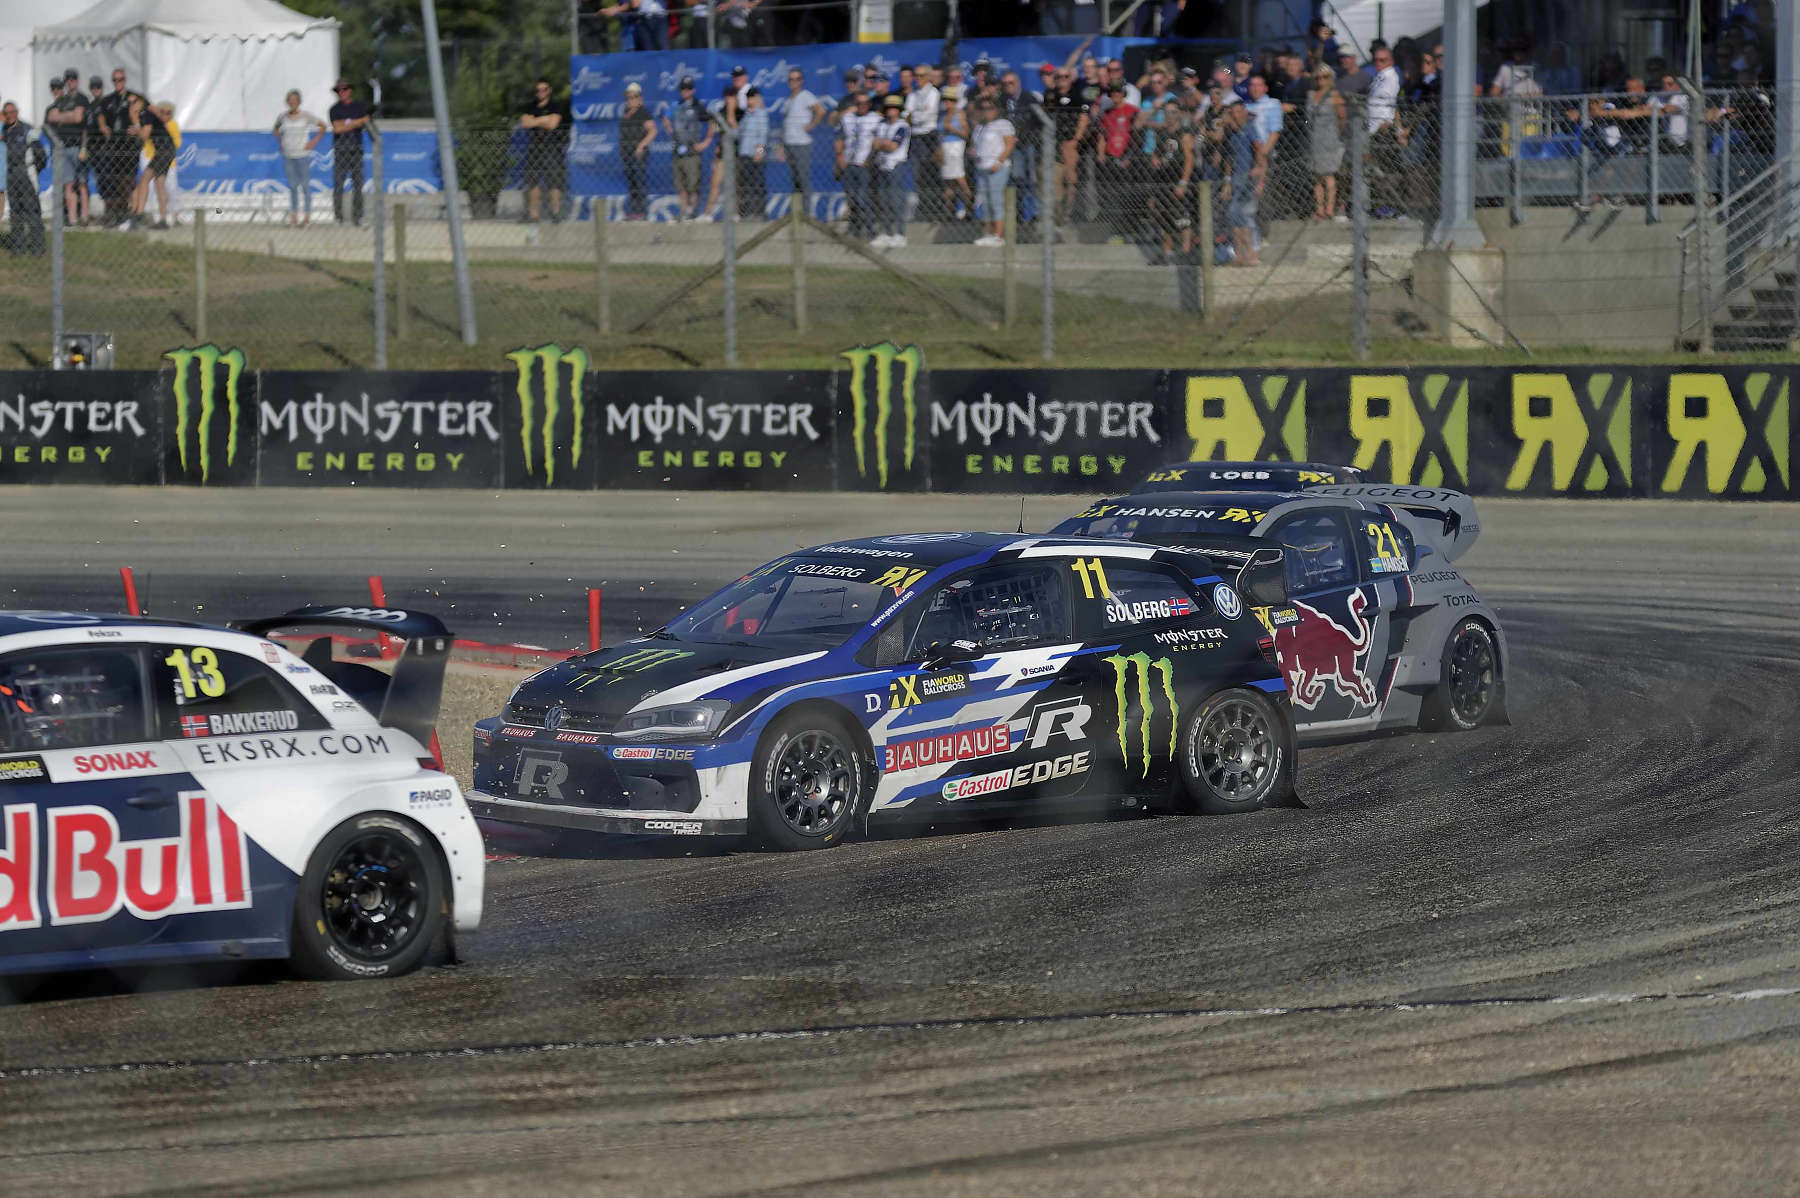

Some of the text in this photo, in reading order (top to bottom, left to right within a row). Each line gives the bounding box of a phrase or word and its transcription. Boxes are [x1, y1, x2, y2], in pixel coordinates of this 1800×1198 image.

[0, 446, 112, 463] ERGY
[297, 452, 464, 471] ENERGY
[638, 450, 787, 468] ENERGY
[966, 455, 1126, 474] ENERGY
[1210, 471, 1269, 480] LOEB
[1114, 507, 1215, 519] HANSEN
[1368, 522, 1400, 558] 21
[788, 564, 866, 578] SOLBERG
[1071, 557, 1110, 599] 11
[1106, 599, 1170, 624] SOLBERG
[1172, 641, 1222, 652] ENERGY
[165, 647, 226, 698] 13
[1028, 664, 1055, 675] SCANIA
[923, 681, 966, 696] RALLYCROSS
[209, 710, 298, 734] BAKKERUD
[556, 733, 599, 744] BAUHAUS
[197, 734, 390, 764] EKSRX.COM
[622, 748, 695, 761] Castrol EDGE
[73, 750, 157, 774] SONAX
[958, 750, 1091, 798] Castrol EDGE
[644, 821, 702, 831] COOPER
[48, 790, 252, 925] Bull
